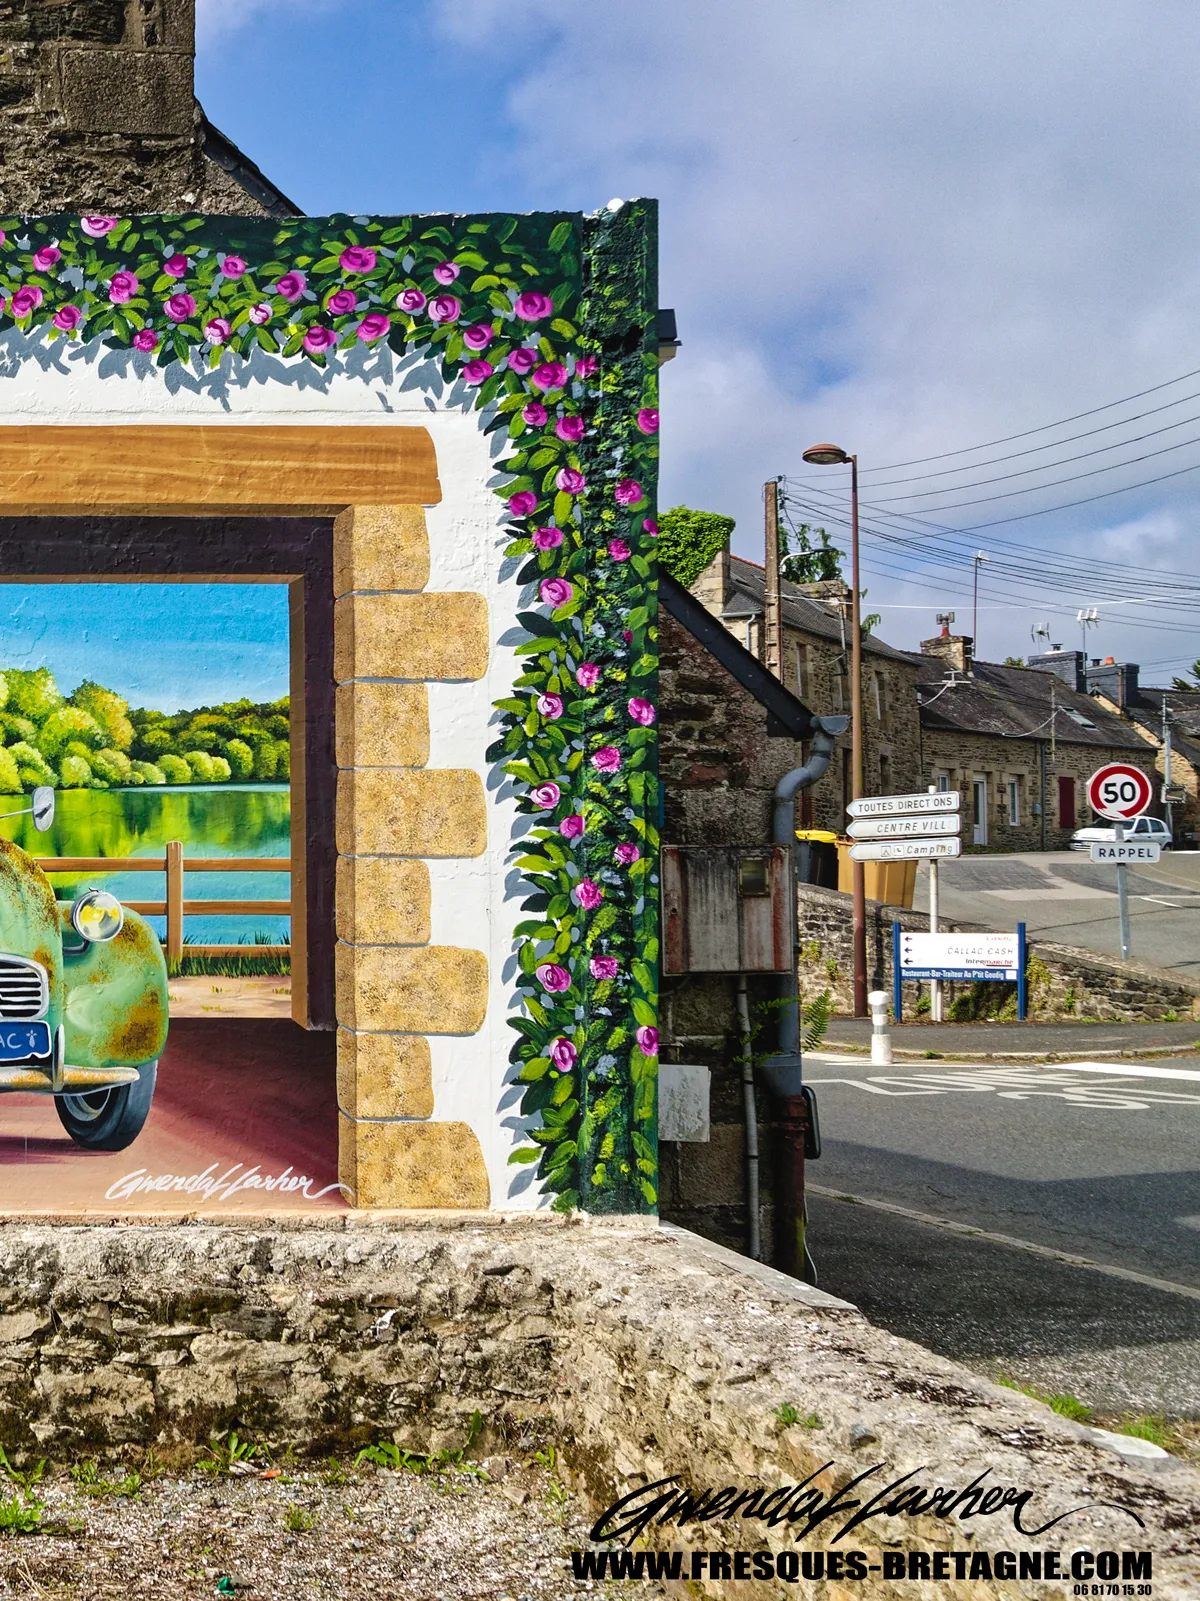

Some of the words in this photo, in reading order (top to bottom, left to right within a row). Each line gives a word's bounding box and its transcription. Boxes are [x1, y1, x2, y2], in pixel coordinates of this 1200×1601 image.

[1104, 782, 1136, 803] 50
[859, 801, 893, 812] TOUTES
[898, 797, 952, 810] DIRECTONS
[877, 822, 918, 833] CENTRE
[922, 820, 951, 831] VILL
[907, 844, 952, 855] Camping
[1099, 848, 1153, 858] RAPPEL
[947, 947, 983, 955] CALLAC
[987, 947, 1014, 956] CASH
